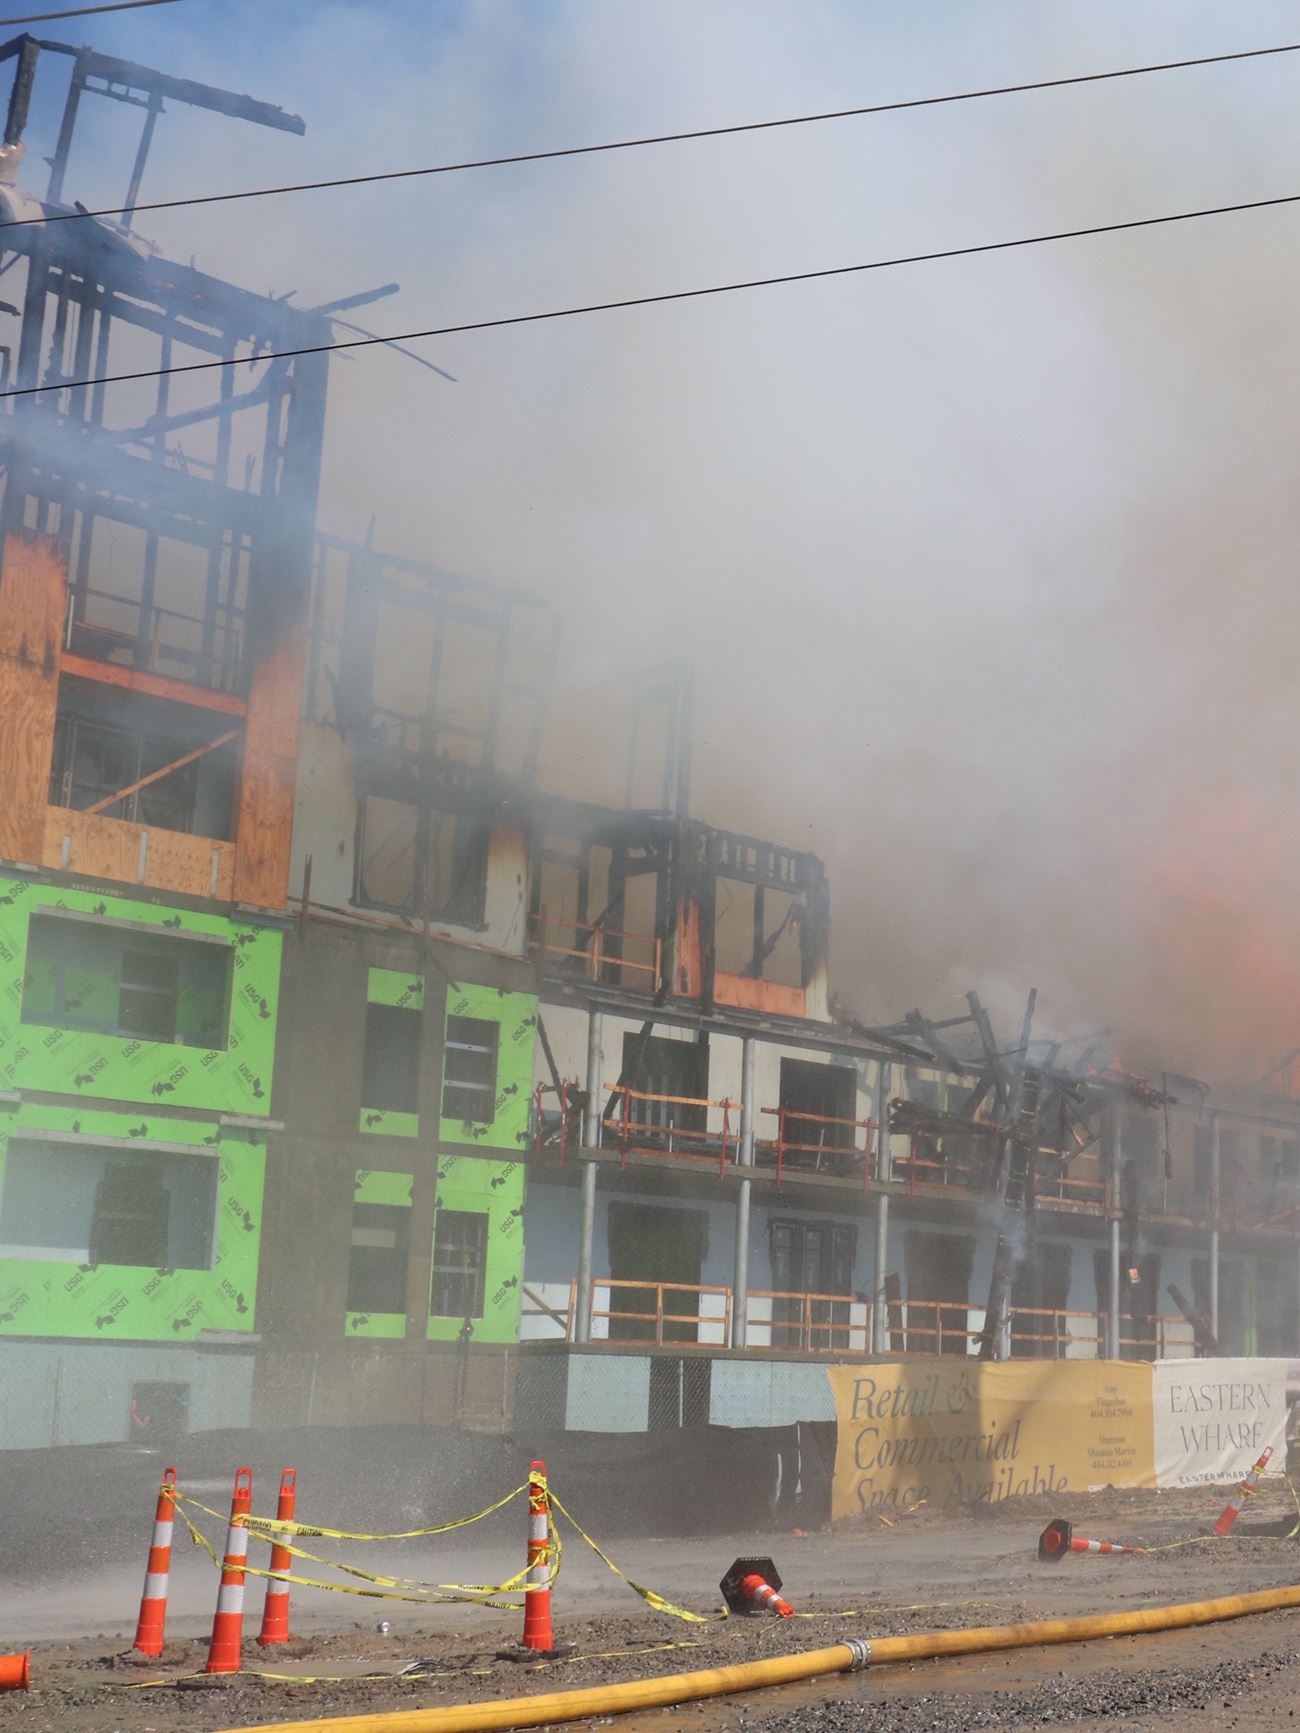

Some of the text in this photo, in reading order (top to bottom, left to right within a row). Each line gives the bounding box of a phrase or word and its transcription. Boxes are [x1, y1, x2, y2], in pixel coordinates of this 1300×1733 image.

[0, 942, 14, 964] US
[244, 983, 261, 1004] USG
[453, 997, 469, 1015] USG
[43, 1029, 63, 1048] USG
[511, 1025, 527, 1042] USG
[121, 1040, 141, 1058] USG
[89, 1056, 109, 1076] USG
[169, 1066, 189, 1085] USG
[238, 1062, 255, 1083] USG
[227, 1196, 245, 1217] USG
[499, 1216, 515, 1234] USG
[63, 1272, 85, 1293] USG
[142, 1276, 161, 1297] USG
[221, 1279, 238, 1299] USG
[8, 1293, 31, 1313] USG
[110, 1296, 130, 1317] USG
[492, 1287, 507, 1306] USG
[851, 1374, 938, 1420] Retail
[1170, 1383, 1271, 1414] EASTERN
[854, 1419, 1021, 1470] Commercial
[1180, 1422, 1263, 1453] WHARF
[296, 1526, 323, 1537] CAUTION
